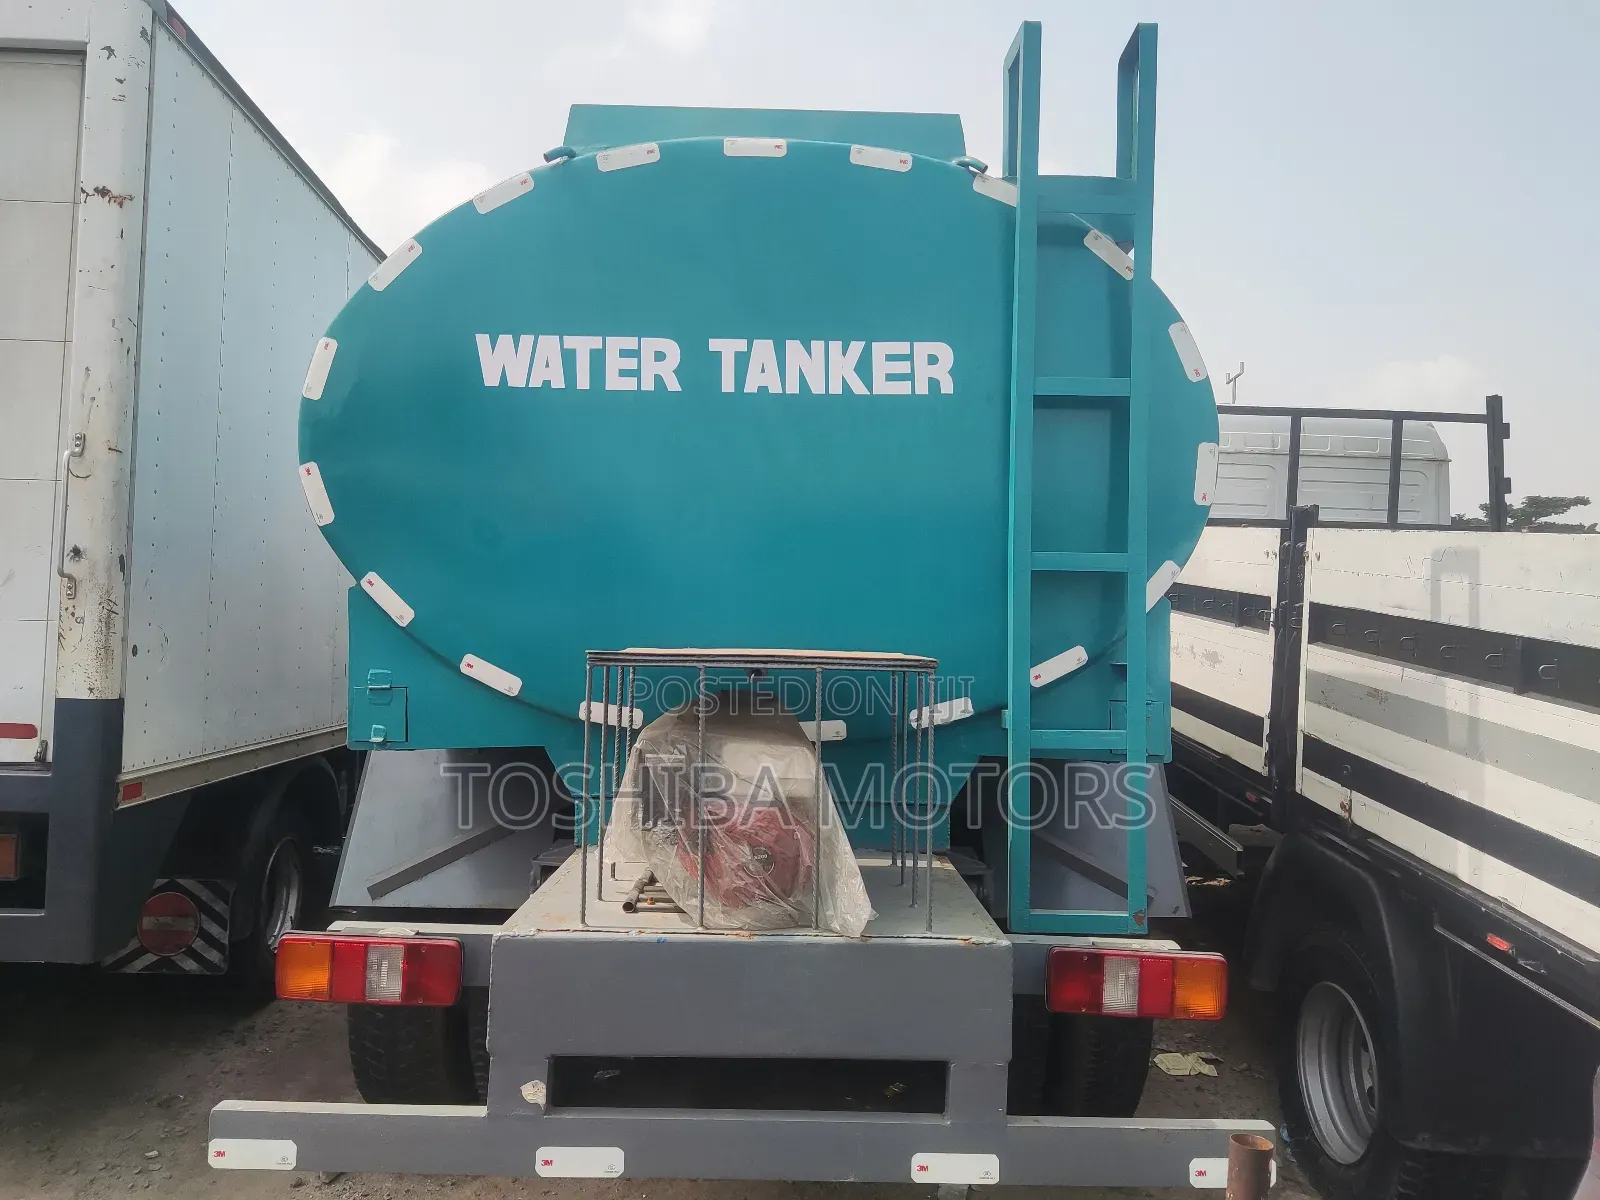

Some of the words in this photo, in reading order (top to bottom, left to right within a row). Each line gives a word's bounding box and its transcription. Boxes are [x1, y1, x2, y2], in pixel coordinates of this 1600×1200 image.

[475, 334, 682, 392] WATER
[708, 338, 955, 395] TANKER
[365, 578, 375, 588] 3M
[465, 661, 474, 669] 3M
[213, 1150, 226, 1158] 3M
[541, 1159, 553, 1167] 3M
[916, 1164, 929, 1173] 3M
[1194, 1169, 1207, 1177] 3M
